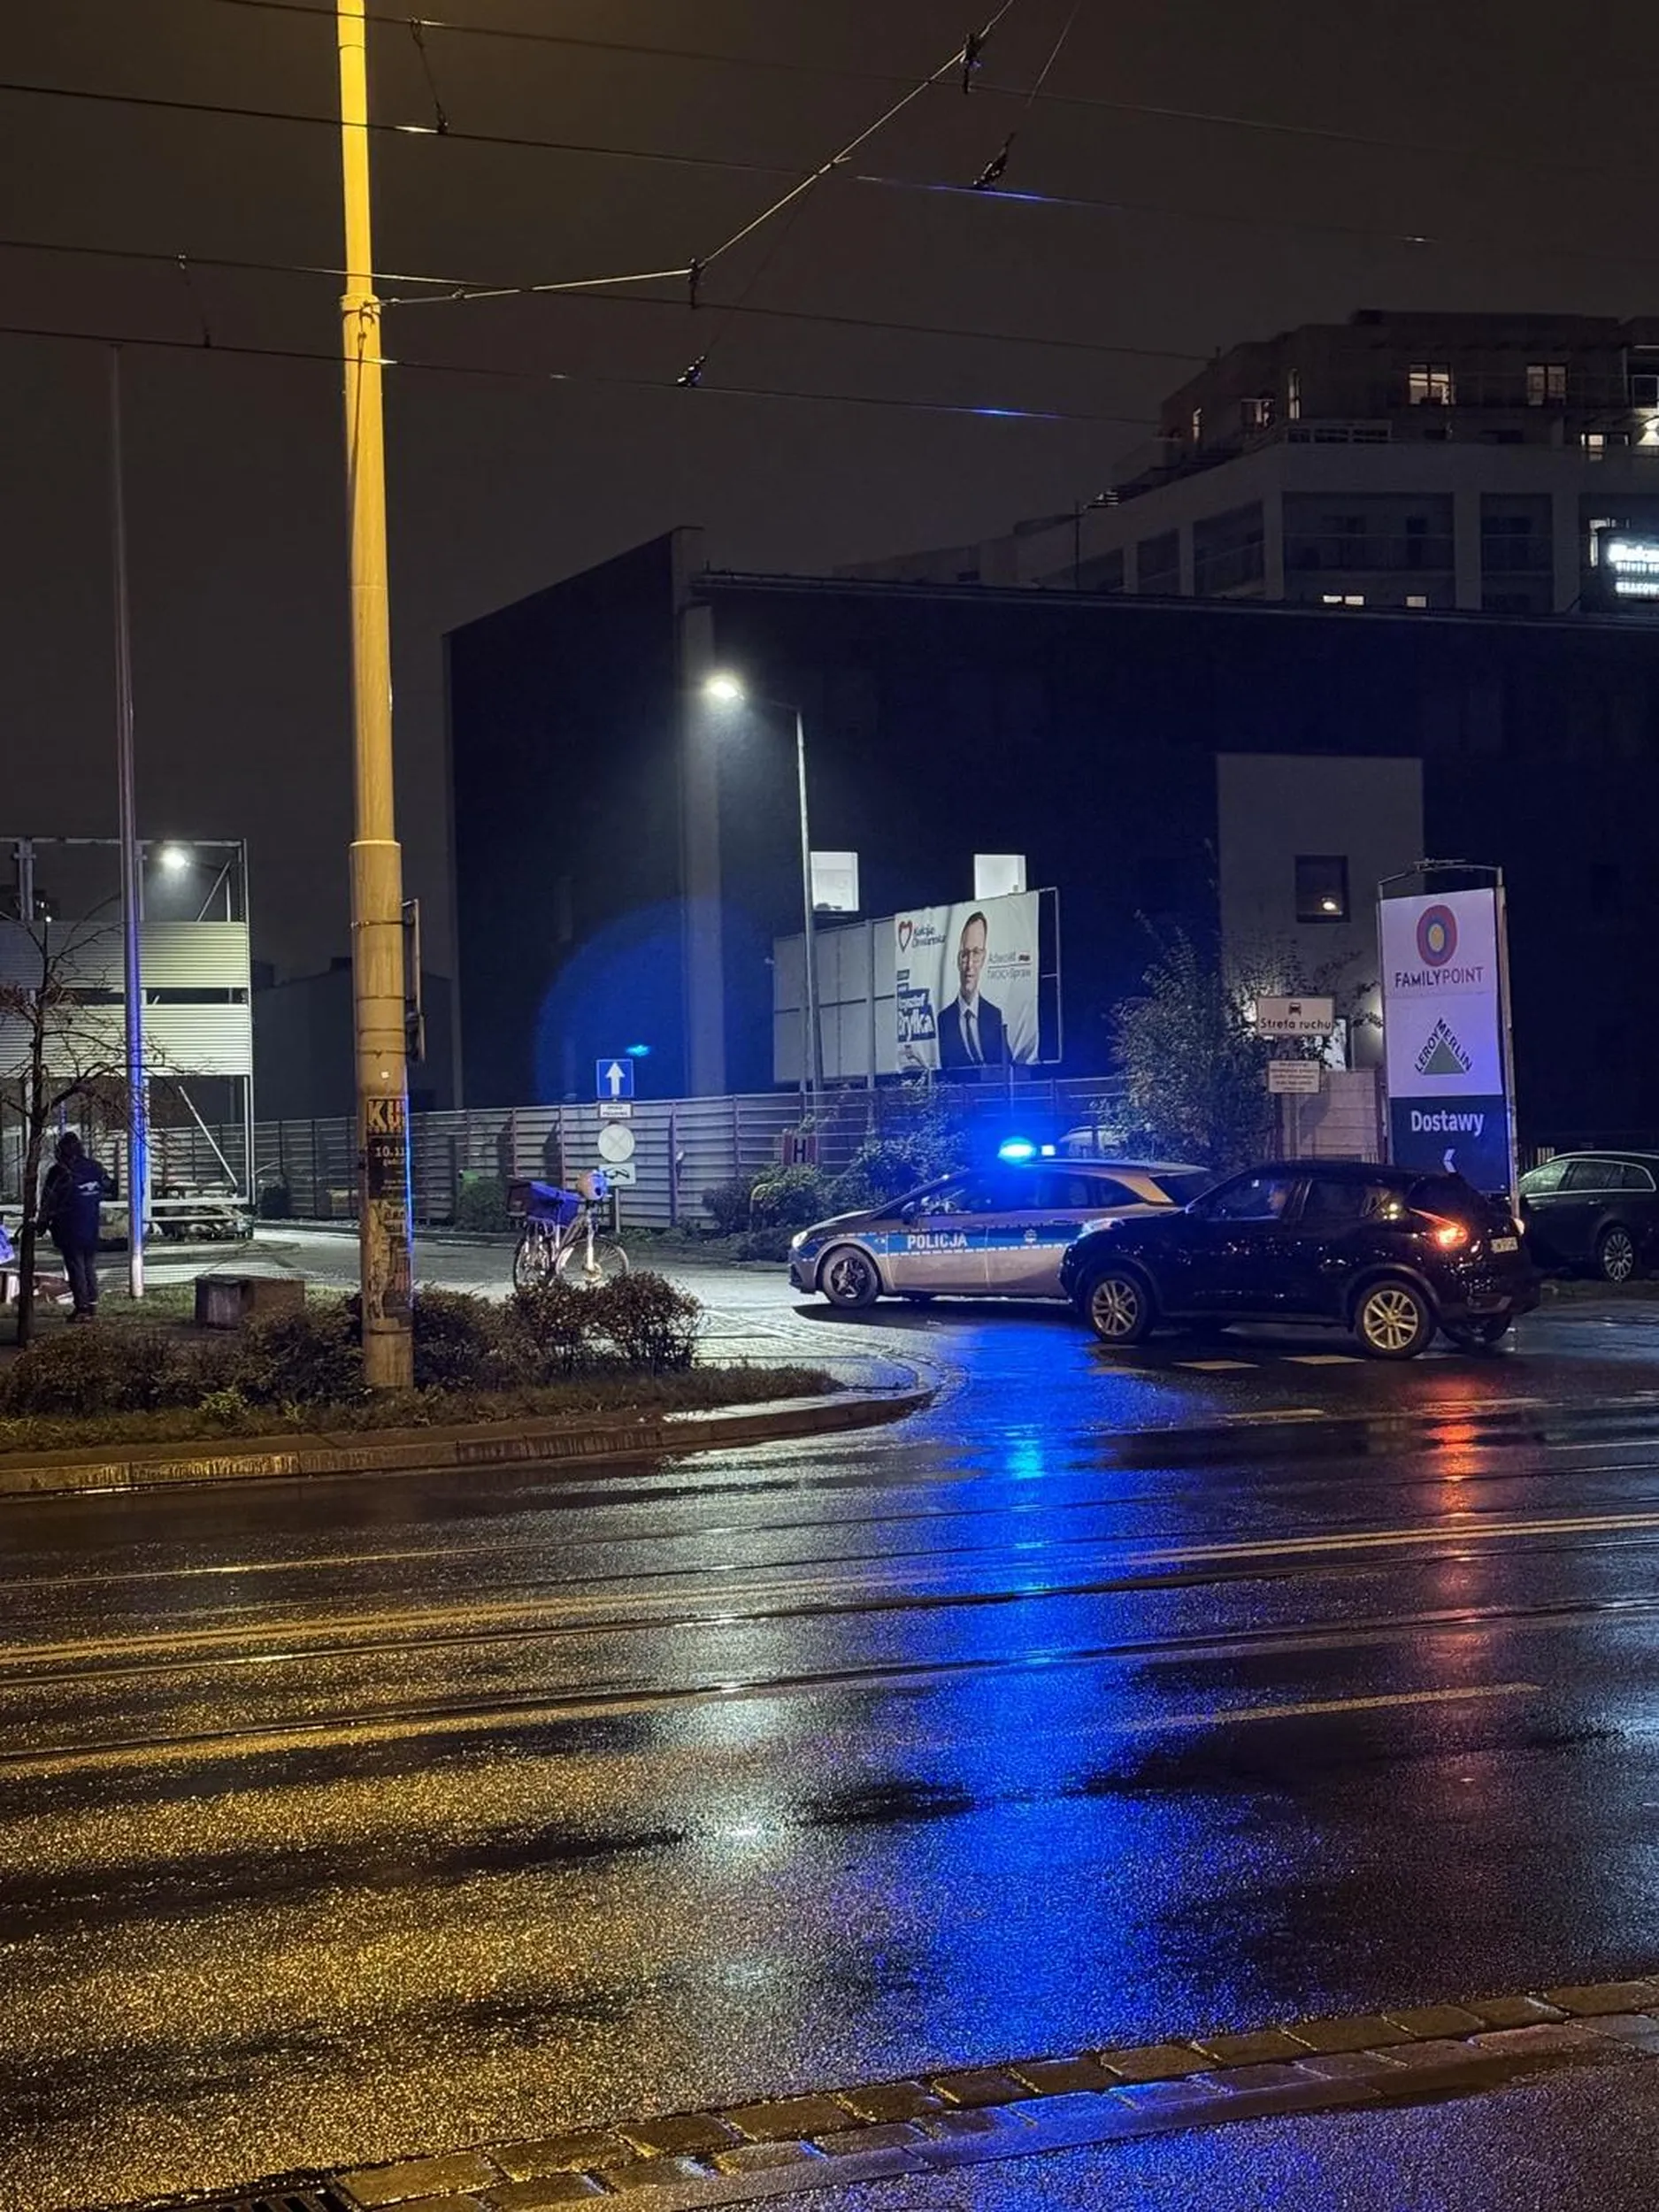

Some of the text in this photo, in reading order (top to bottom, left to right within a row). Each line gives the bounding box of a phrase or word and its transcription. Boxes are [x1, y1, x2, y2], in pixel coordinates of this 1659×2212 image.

[1395, 966, 1484, 987] FAMILYPOINT
[1260, 1018, 1331, 1029] Strefa ruchu
[1415, 1018, 1473, 1072] LEROY MERLIN
[1411, 1110, 1484, 1137] Dostawy
[907, 1232, 967, 1249] POLICJA
